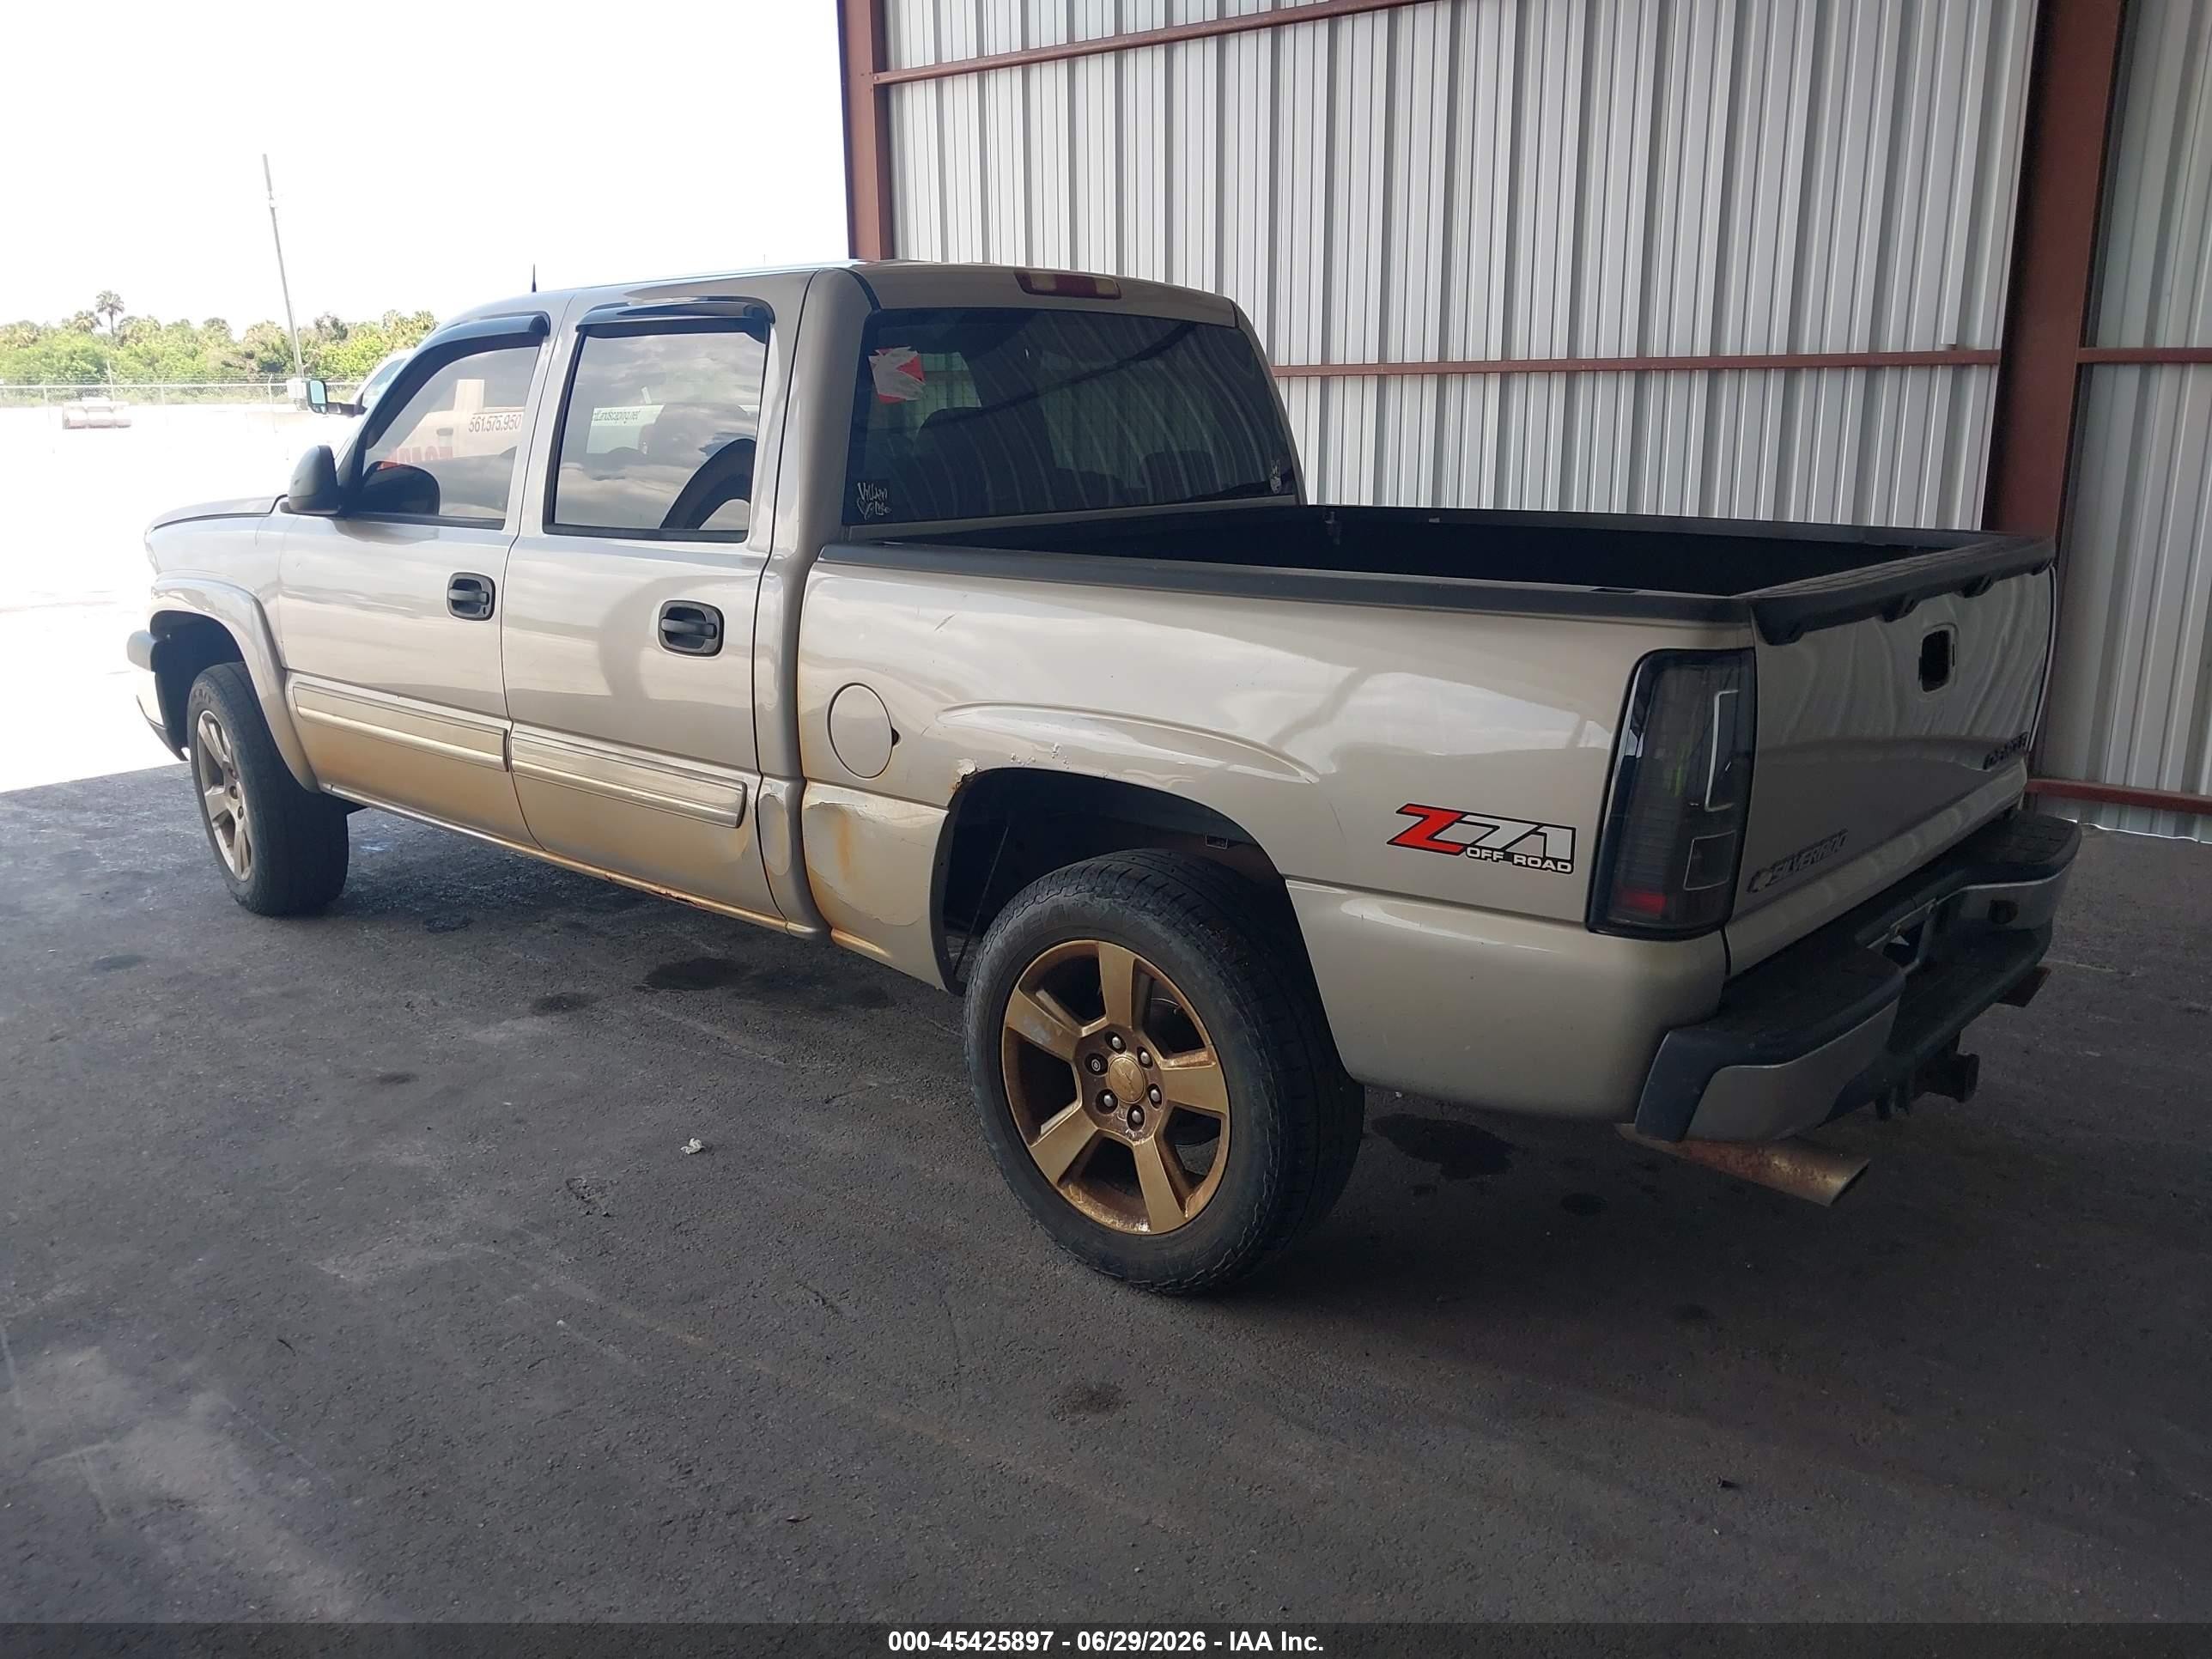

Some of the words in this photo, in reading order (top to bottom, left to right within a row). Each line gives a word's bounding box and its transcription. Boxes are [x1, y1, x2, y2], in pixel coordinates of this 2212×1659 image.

[1387, 803, 1577, 863] Z71
[1466, 847, 1504, 861] OFF
[1513, 855, 1572, 873] ROAD
